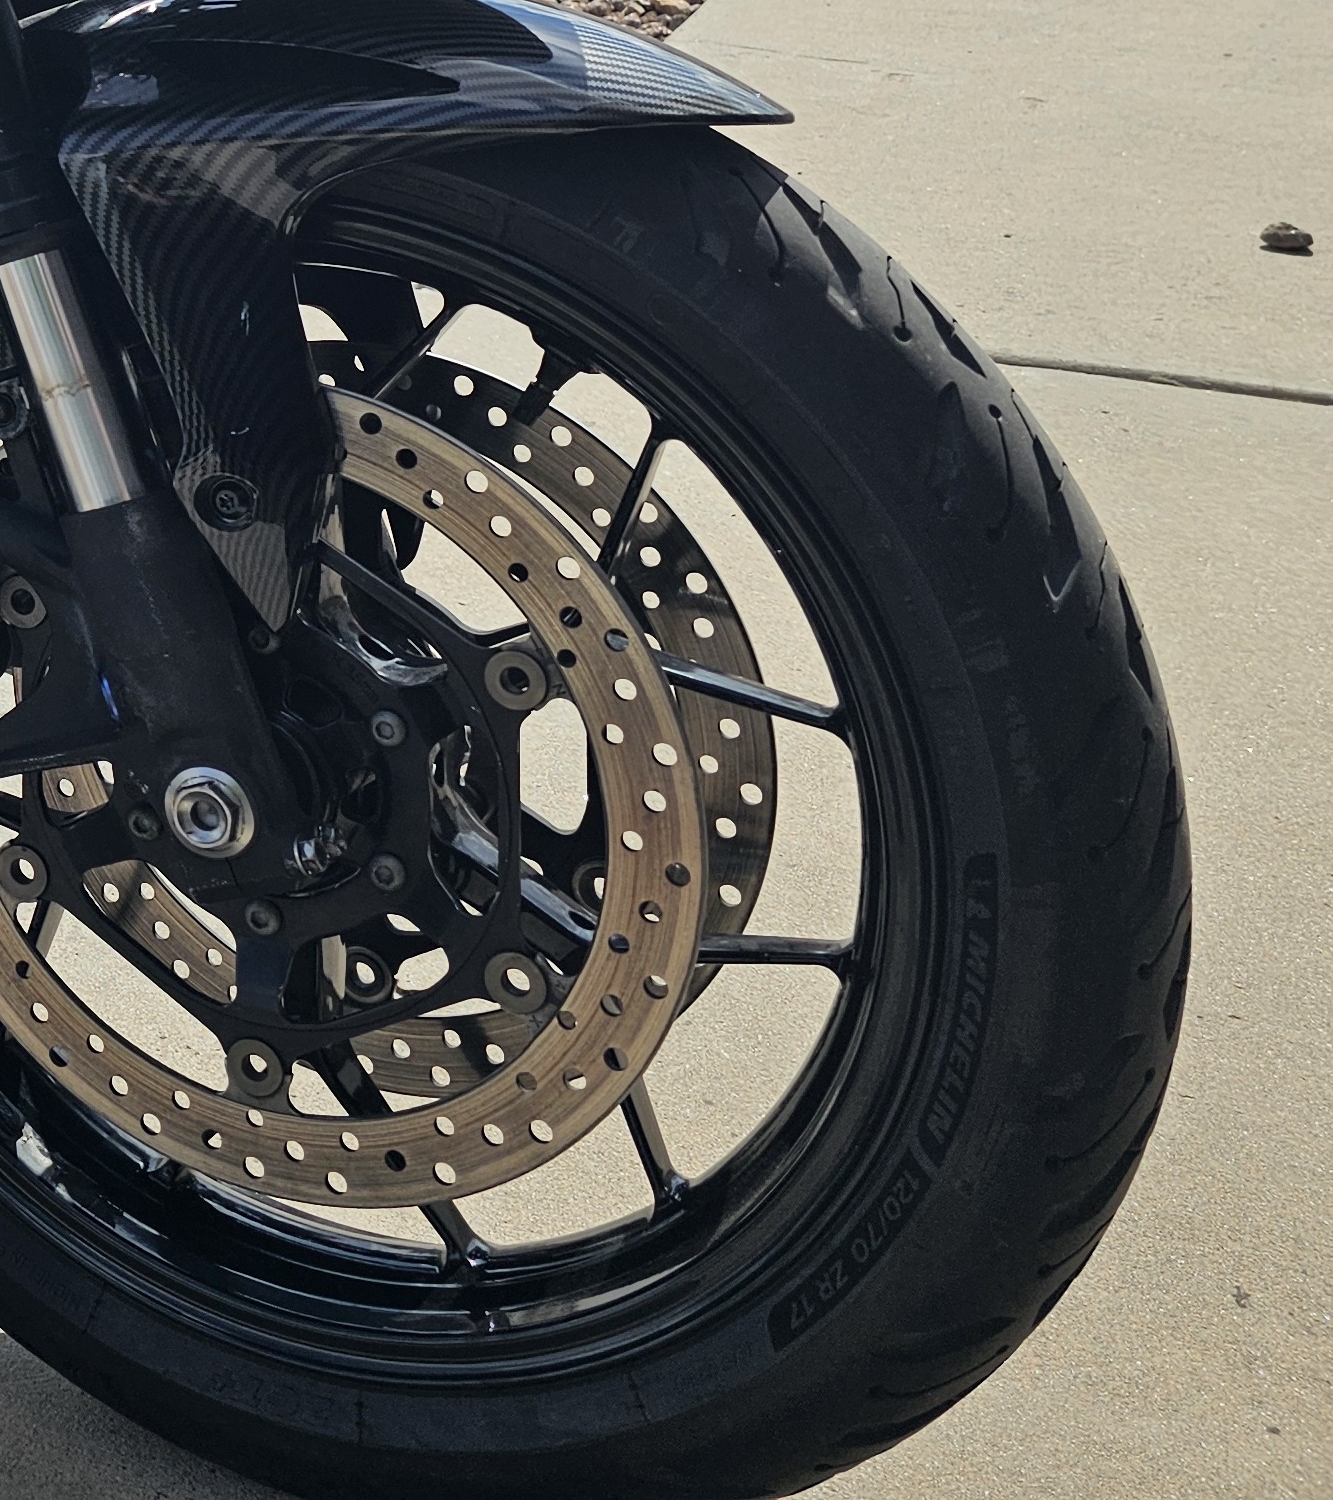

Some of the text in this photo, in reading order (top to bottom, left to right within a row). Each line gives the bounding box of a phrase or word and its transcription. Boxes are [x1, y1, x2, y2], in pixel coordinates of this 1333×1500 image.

[789, 936, 992, 1331] MICHELIN 120/70 ZR 17
